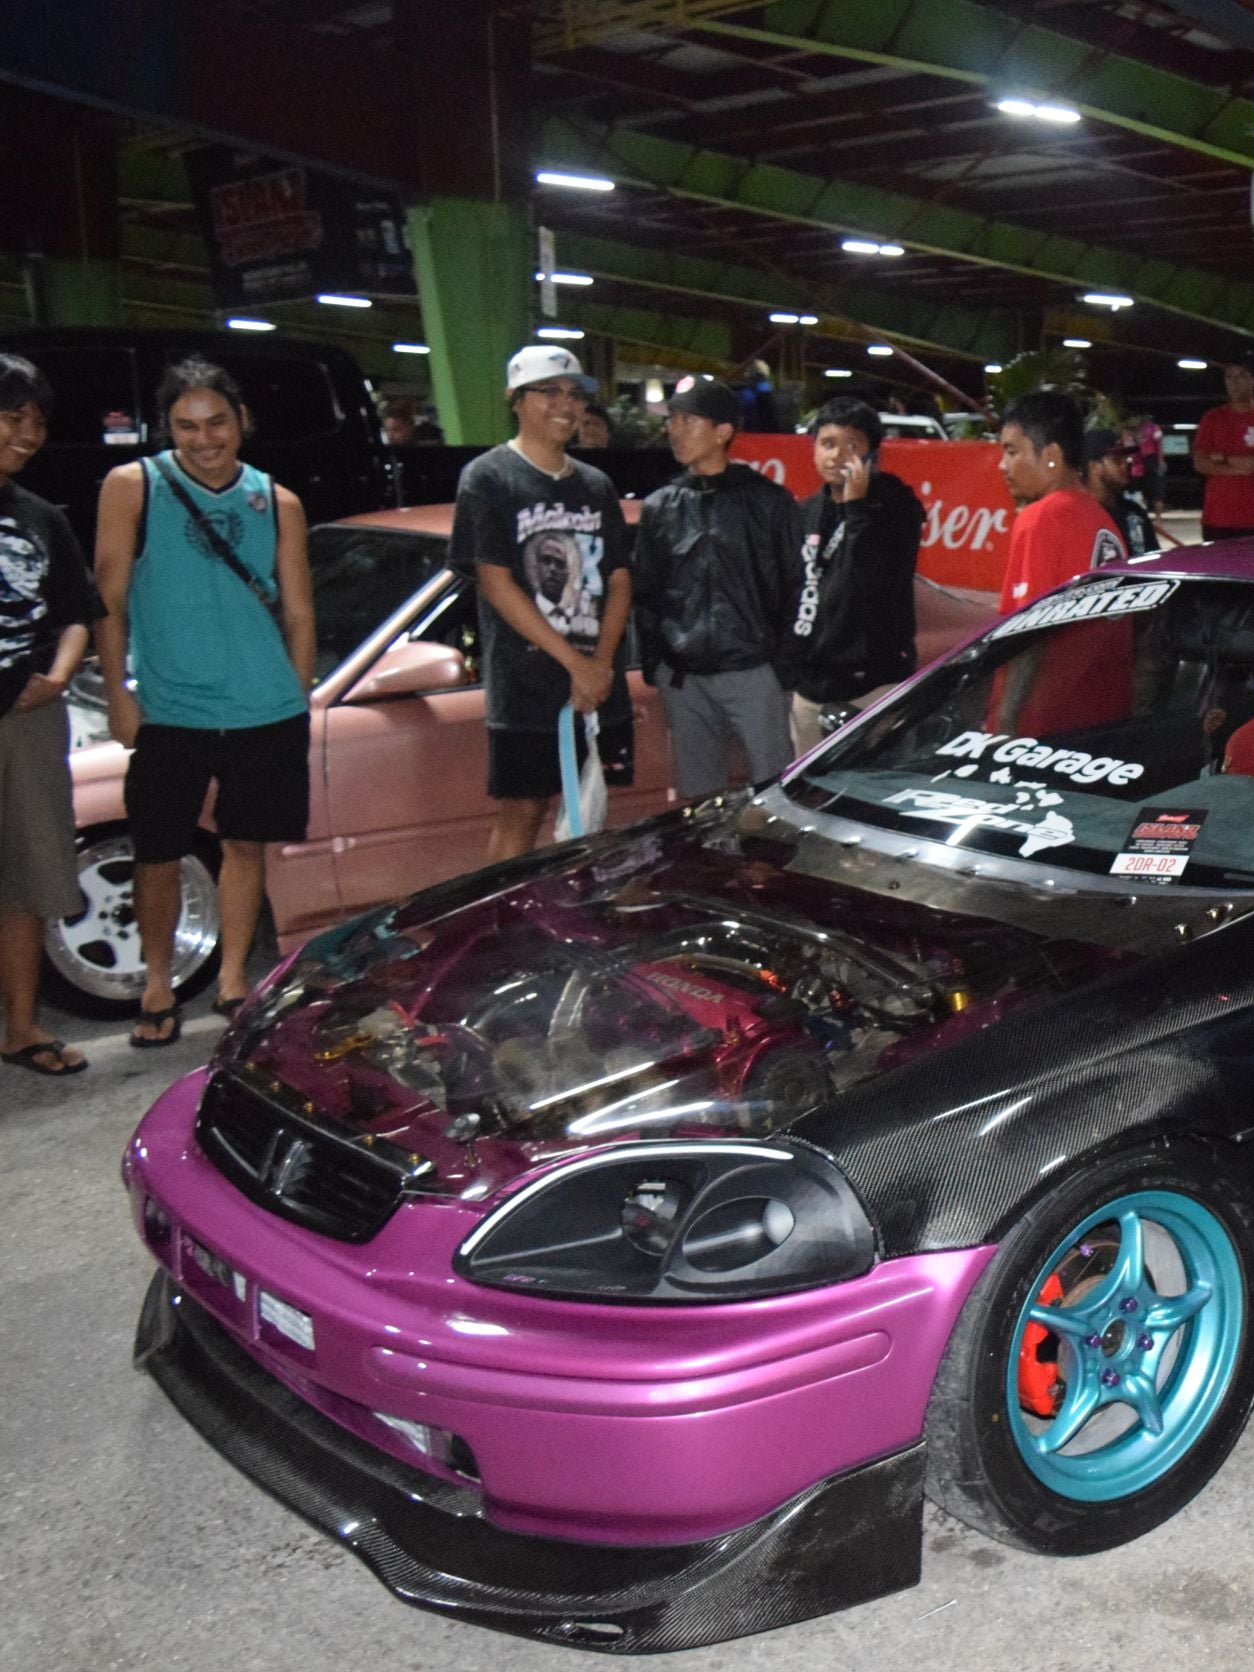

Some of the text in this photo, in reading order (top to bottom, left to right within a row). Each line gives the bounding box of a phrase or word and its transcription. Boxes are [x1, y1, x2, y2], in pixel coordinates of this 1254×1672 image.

[992, 583, 1171, 640] UNRATED
[935, 731, 1145, 785] DK Garage
[881, 788, 1023, 815] Red
[899, 808, 1070, 846] Zone
[1125, 857, 1177, 872] 2DR-02
